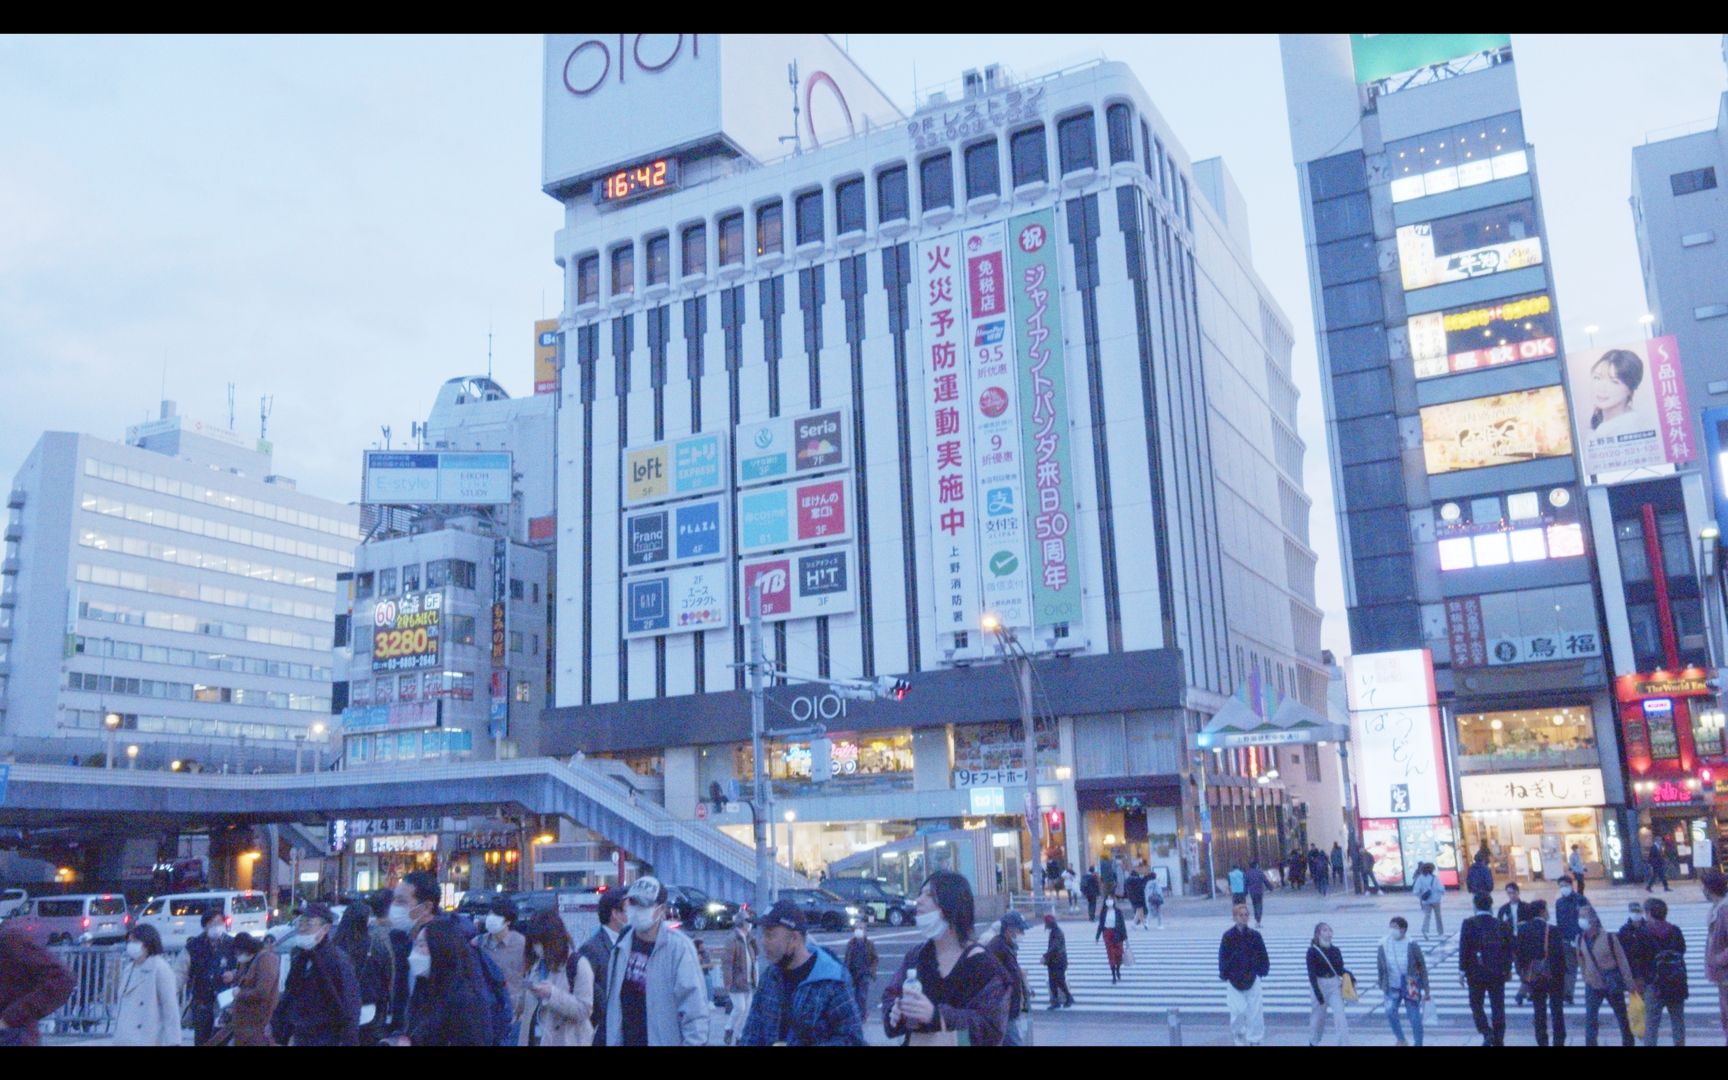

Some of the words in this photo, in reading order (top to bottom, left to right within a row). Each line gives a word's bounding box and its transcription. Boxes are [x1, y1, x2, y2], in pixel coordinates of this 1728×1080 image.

[606, 161, 666, 198] 16:42
[1022, 227, 1043, 251] 祝
[979, 260, 996, 312] 免税店
[978, 345, 1004, 364] 9.5
[927, 245, 965, 537] 火災予防運動実施中
[1657, 362, 1690, 459] 品川美容外科
[800, 421, 837, 439] Seria
[1024, 264, 1068, 592] ジャイアントパンダ来日50周年
[991, 434, 1002, 451] 9
[679, 444, 716, 466] ニトリ
[813, 456, 825, 466] 7F
[377, 476, 430, 491] E-style
[460, 489, 489, 497] STUDY
[801, 493, 839, 508] ほけんの
[680, 521, 716, 535] PLAZA
[815, 525, 828, 536] 3F
[986, 517, 1018, 534] 支付宝
[692, 545, 704, 553] 4F
[643, 552, 653, 563] 4F
[693, 576, 704, 585] 2F
[950, 546, 963, 623] 上野消防署
[688, 586, 709, 597] エース
[640, 593, 656, 609] GAP
[681, 596, 717, 609] コンタクト
[762, 603, 774, 614] 3F
[643, 619, 654, 630] 2F
[1662, 681, 1689, 692] World
[1504, 778, 1569, 800] ねぎし
